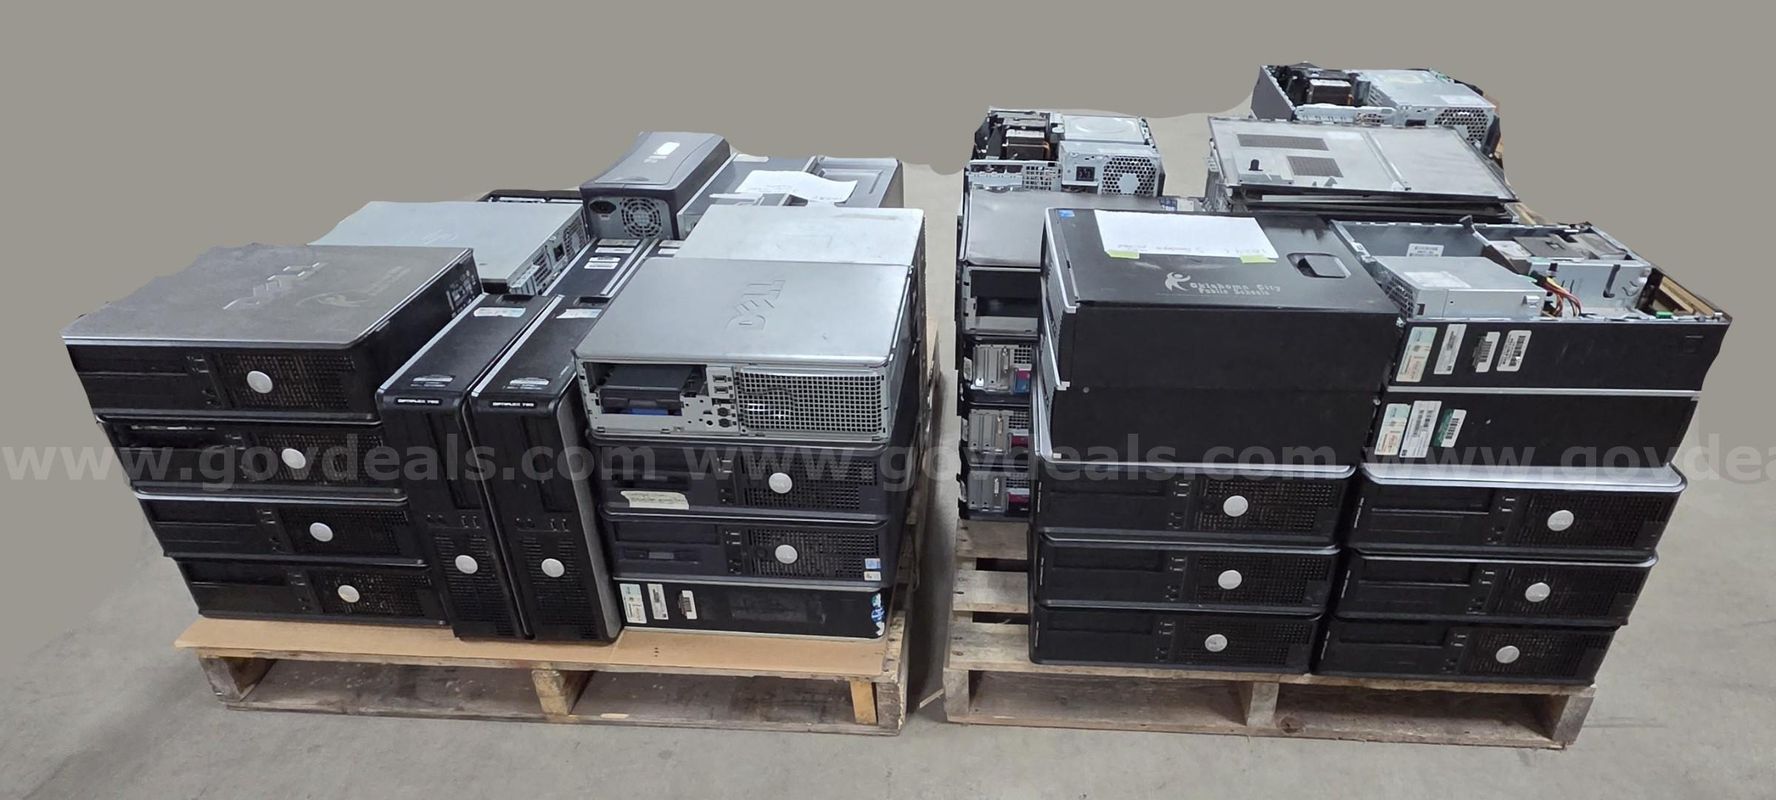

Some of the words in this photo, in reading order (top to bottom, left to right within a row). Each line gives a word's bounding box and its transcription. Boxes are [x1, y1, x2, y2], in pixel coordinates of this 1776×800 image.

[1190, 282, 1249, 290] Oklahoma
[1256, 283, 1280, 292] City
[724, 279, 786, 330] DELL
